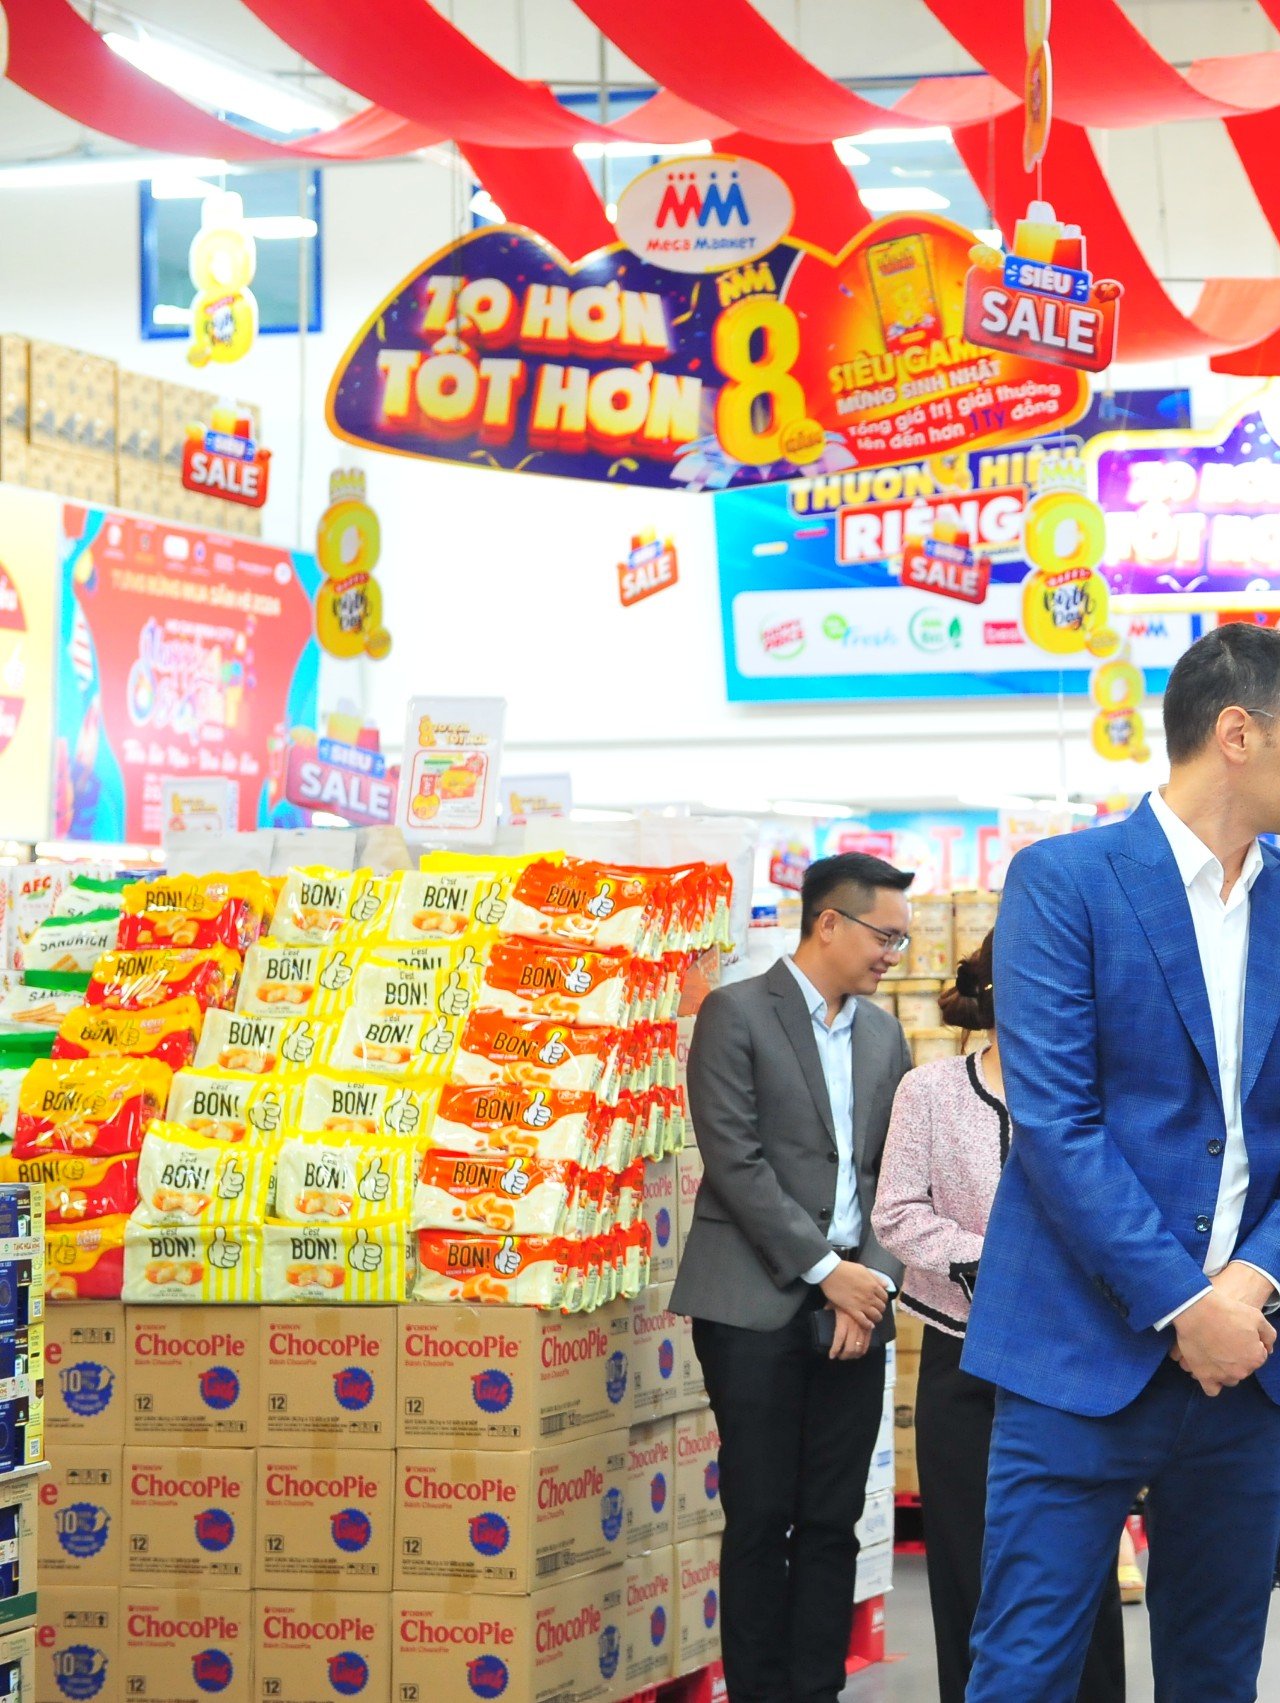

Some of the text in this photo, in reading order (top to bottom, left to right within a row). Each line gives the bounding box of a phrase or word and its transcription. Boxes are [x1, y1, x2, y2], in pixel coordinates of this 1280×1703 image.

[1018, 263, 1073, 294] SIÊU
[520, 280, 670, 349] HƠN
[980, 290, 1097, 354] SALE
[905, 336, 996, 375] GAM
[377, 315, 703, 442] TỐT HƠN
[901, 372, 947, 399] SINH
[949, 359, 1002, 386] NHẬT
[895, 406, 926, 431] giá
[928, 396, 952, 420] trị
[957, 386, 993, 416] giải
[889, 428, 926, 449] đến
[928, 422, 965, 443] hơn
[190, 451, 260, 499] SALE
[621, 557, 672, 600] SALE
[910, 555, 979, 598] SALE
[300, 762, 392, 821] SALE
[300, 884, 343, 909] BON!
[423, 886, 468, 912] BON!
[546, 886, 588, 911] BON!
[266, 958, 312, 981] BON!
[521, 966, 562, 989] BON!
[385, 982, 428, 1006] BON!
[228, 1021, 275, 1049] BON!
[366, 1024, 414, 1044] BON!
[193, 1091, 239, 1118] BON!
[332, 1090, 378, 1116] BON!
[475, 1098, 521, 1122] BON!
[18, 1160, 60, 1184] BON!
[161, 1164, 210, 1190] BON!
[304, 1162, 347, 1190] BON!
[453, 1161, 498, 1188] BON!
[150, 1236, 196, 1258] BON!
[291, 1236, 337, 1261] BON!
[447, 1244, 490, 1269] BON!
[135, 1333, 245, 1356] ChocoPie
[269, 1332, 379, 1356] ChocoPie
[405, 1333, 518, 1358] ChocoPie
[541, 1327, 608, 1368] ChocoPie
[137, 1396, 151, 1410] 12
[271, 1396, 285, 1410] 12
[407, 1399, 422, 1413] 12
[131, 1473, 241, 1498] ChocoPie
[266, 1473, 378, 1498] ChocoPie
[404, 1477, 516, 1502] ChocoPie
[537, 1465, 604, 1510] ChocoPie
[131, 1537, 146, 1551] 12
[267, 1537, 282, 1551] 12
[405, 1539, 420, 1553] 12
[128, 1615, 239, 1640] ChocoPie
[263, 1617, 375, 1641] ChocoPie
[400, 1620, 514, 1645] ChocoPie
[536, 1603, 602, 1654] ChocoPie
[128, 1678, 144, 1692] 12
[264, 1681, 280, 1694] 12
[401, 1685, 417, 1700] 12
